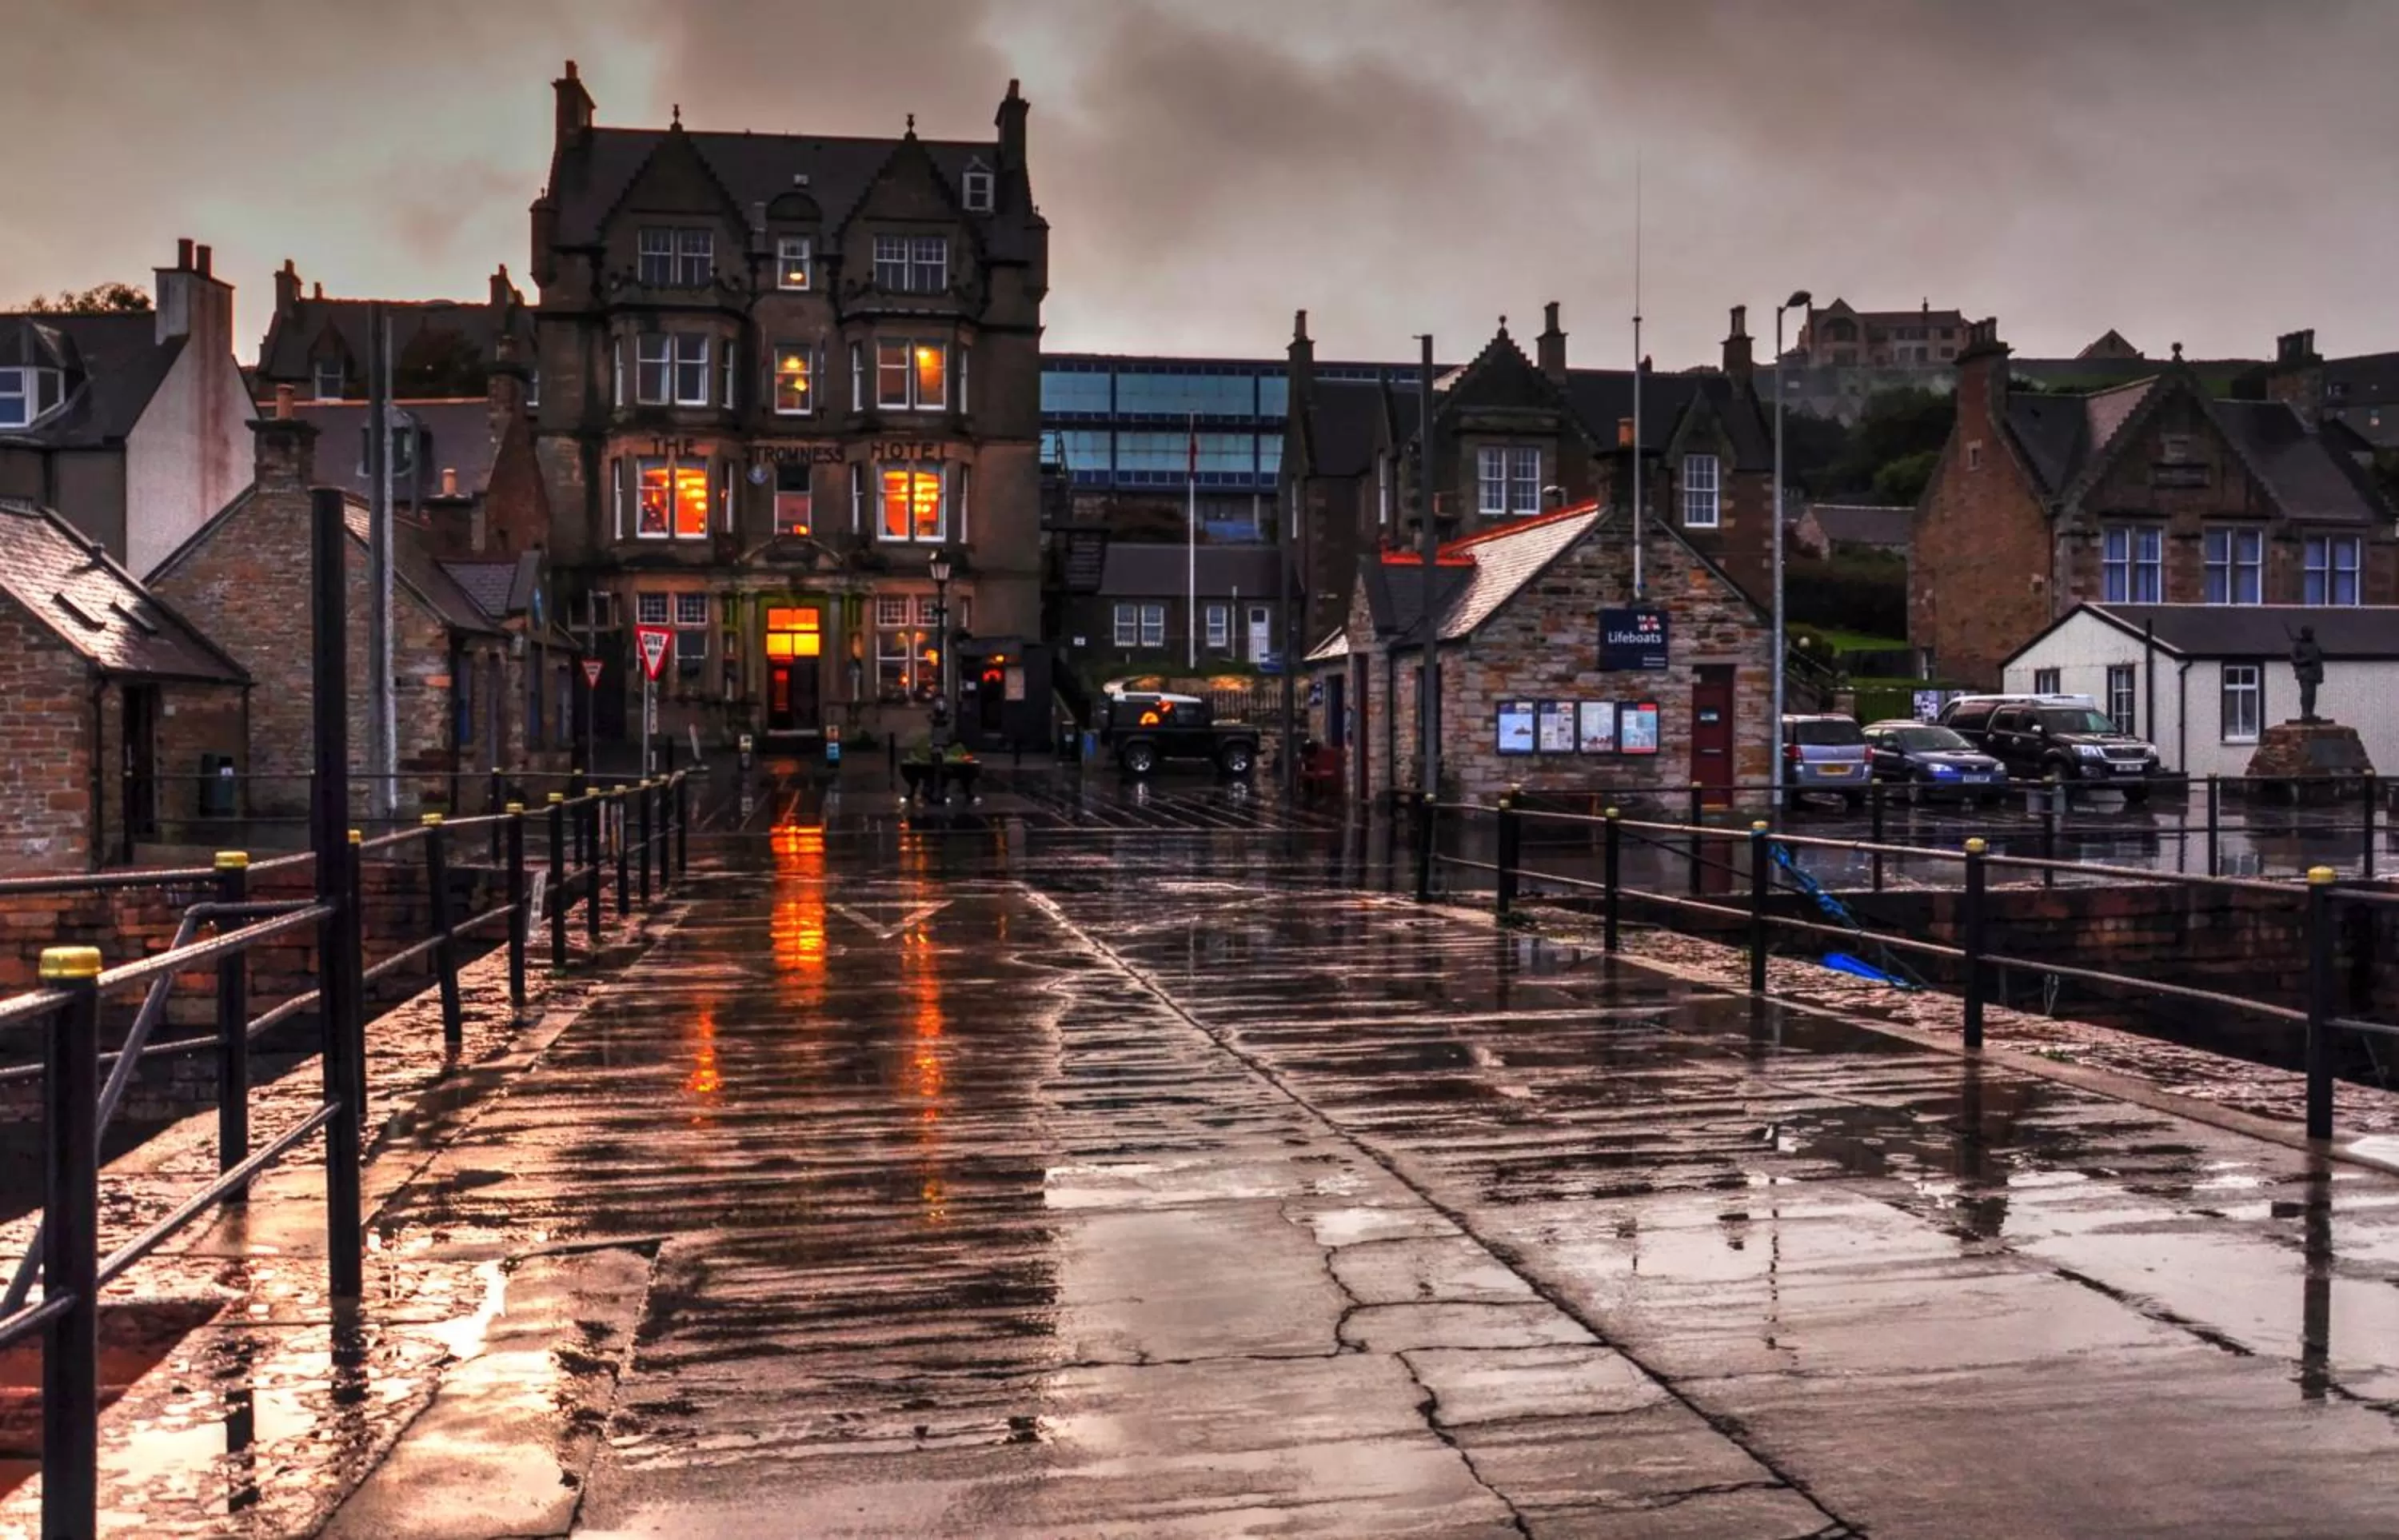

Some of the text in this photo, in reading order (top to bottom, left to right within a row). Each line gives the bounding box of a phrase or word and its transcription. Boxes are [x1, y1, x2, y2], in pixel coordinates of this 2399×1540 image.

[651, 437, 696, 458] THE
[869, 441, 952, 461] HOTEL
[1607, 631, 1663, 644] Lifeboats
